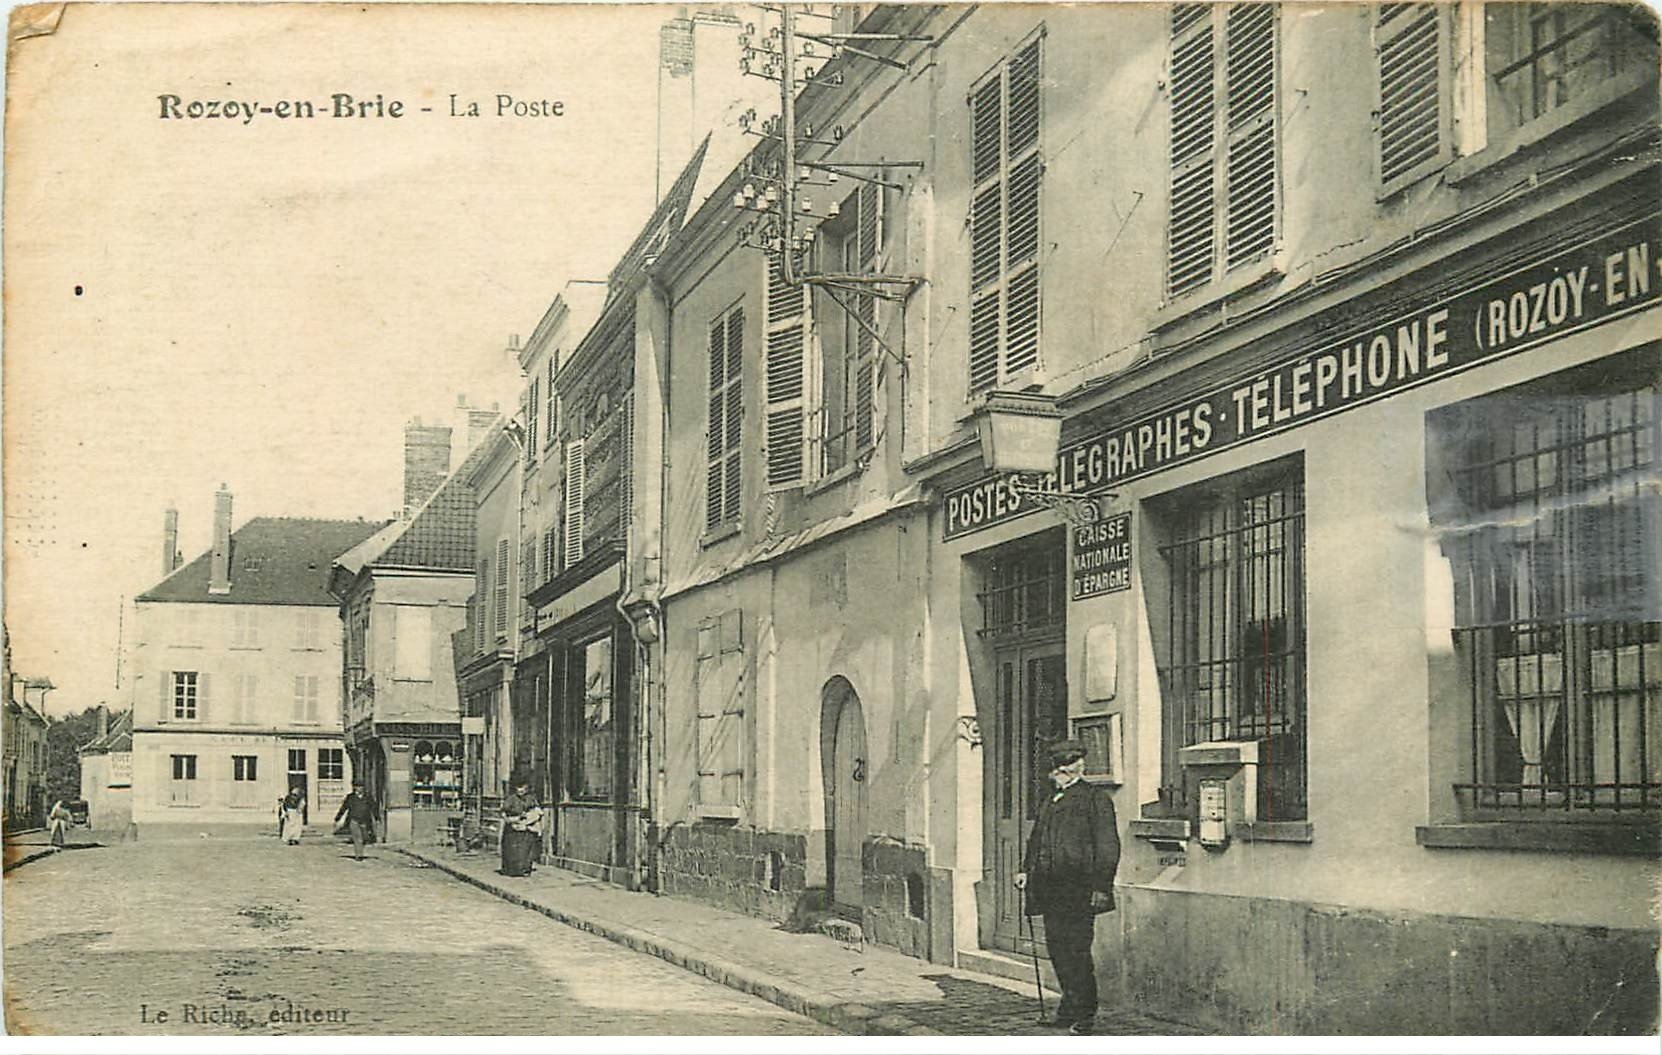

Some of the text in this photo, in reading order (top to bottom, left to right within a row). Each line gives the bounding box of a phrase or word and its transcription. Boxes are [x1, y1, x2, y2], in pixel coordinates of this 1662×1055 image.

[949, 473, 1022, 532] POSTES
[1036, 402, 1213, 496] LÉGRAPHES
[1233, 308, 1450, 436] TÉLÉPHONE
[1079, 519, 1125, 547] CAISSE
[1074, 542, 1130, 572] NATIONALE
[1074, 567, 1130, 596] D'ÉPARGNE
